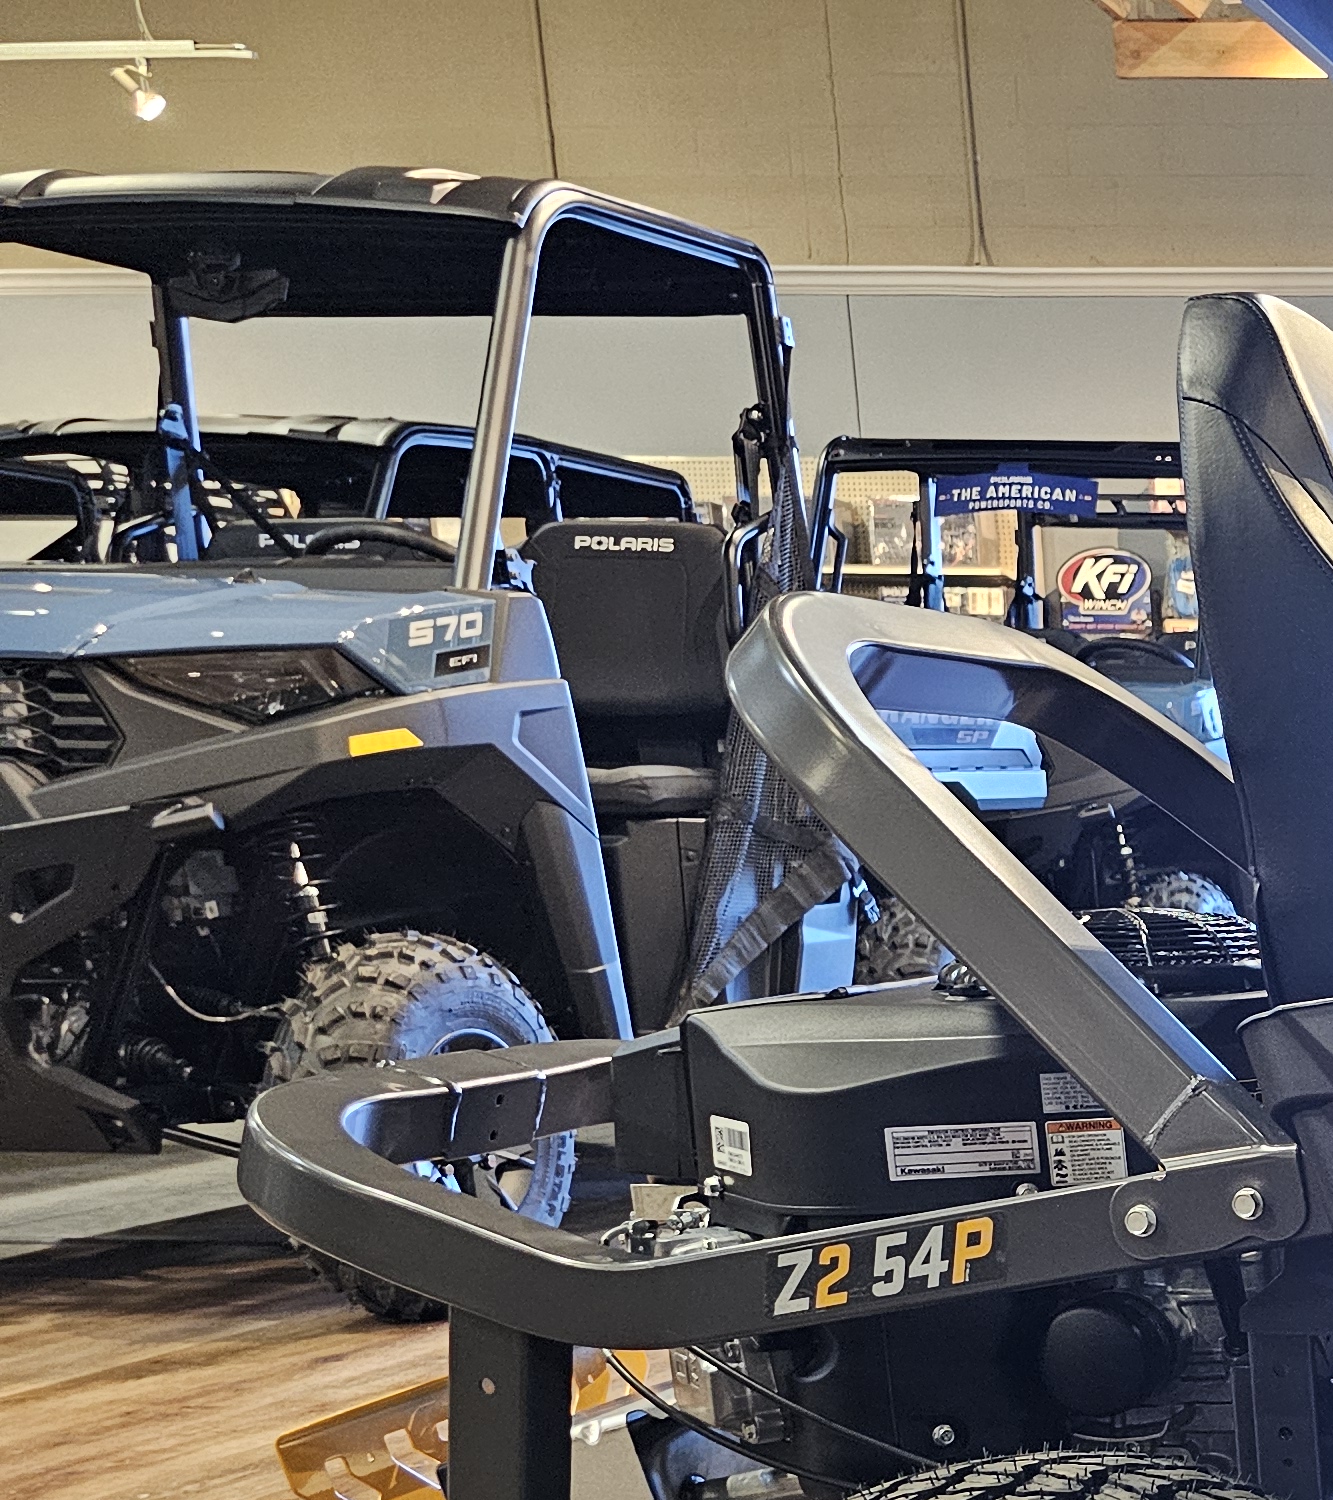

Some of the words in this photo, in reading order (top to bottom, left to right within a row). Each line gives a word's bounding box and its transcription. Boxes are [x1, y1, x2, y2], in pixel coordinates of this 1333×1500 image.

[952, 486, 981, 502] THE
[986, 484, 1077, 503] AMERICAN
[968, 499, 1034, 510] POWERSPORTS
[574, 535, 675, 553] POLARIS
[1084, 598, 1129, 611] WINCH
[408, 611, 483, 647] 570
[956, 730, 990, 744] SP
[1067, 1120, 1113, 1131] WARNING
[900, 1166, 945, 1175] Kawasaki
[772, 1243, 851, 1317] Z2
[871, 1216, 994, 1298] 54P
